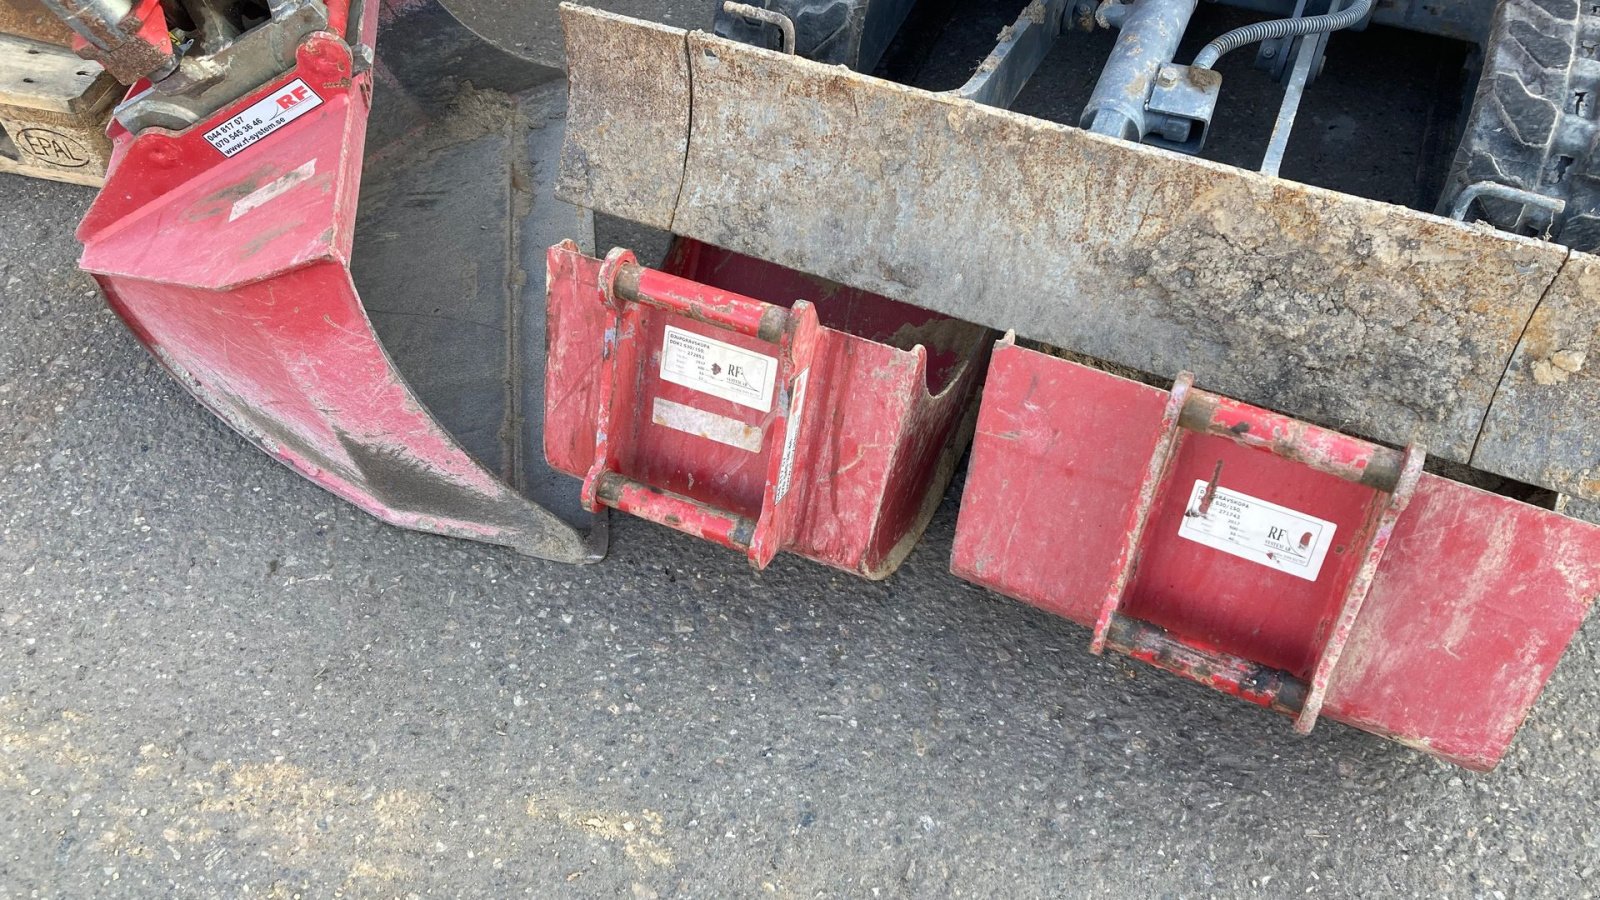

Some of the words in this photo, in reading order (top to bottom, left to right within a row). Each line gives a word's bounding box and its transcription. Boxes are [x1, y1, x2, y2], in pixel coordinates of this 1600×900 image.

[276, 85, 308, 109] RF
[206, 130, 222, 141] 044
[220, 122, 234, 133] 817
[233, 116, 244, 125] 07
[215, 137, 230, 149] 070
[228, 129, 244, 140] 545
[242, 123, 253, 132] 36
[252, 117, 263, 126] 46
[225, 117, 286, 154] www.rf-system.se
[24, 131, 83, 161] EPAL
[1268, 526, 1287, 541] RF
